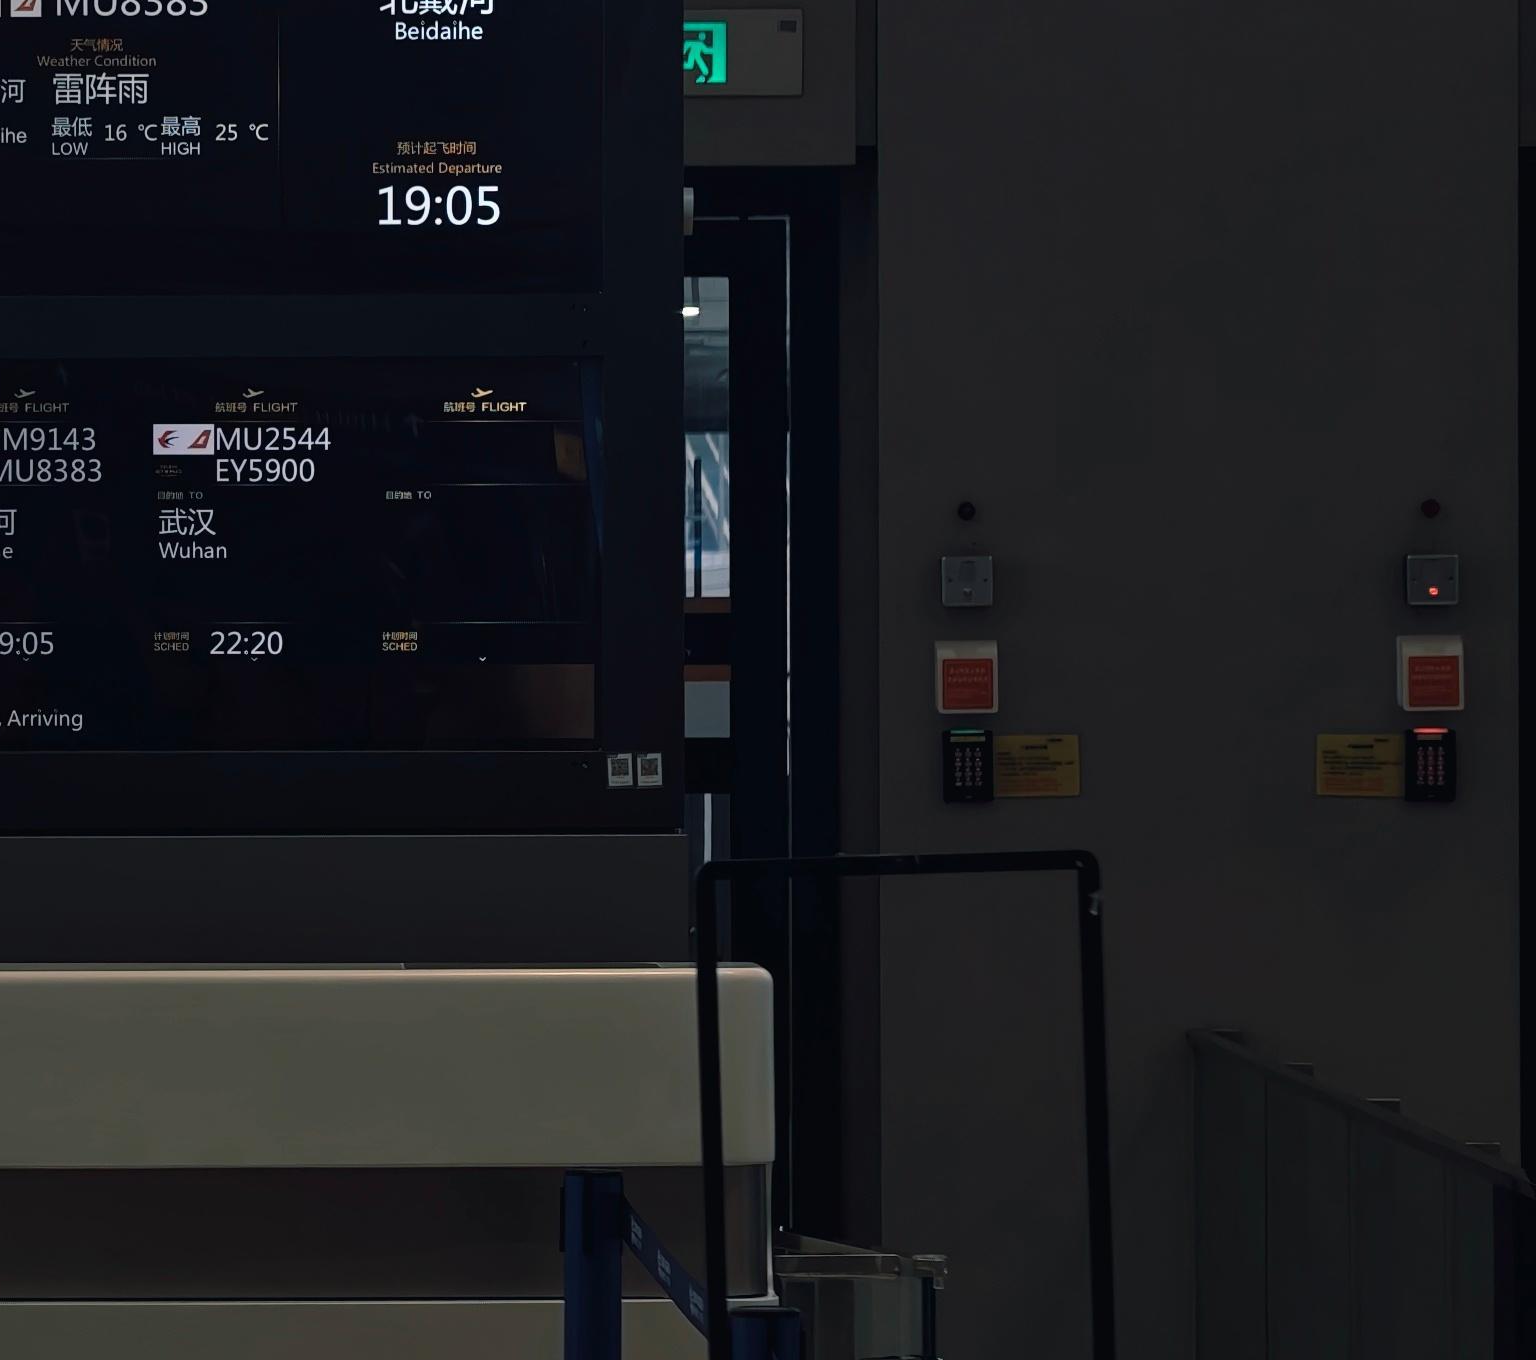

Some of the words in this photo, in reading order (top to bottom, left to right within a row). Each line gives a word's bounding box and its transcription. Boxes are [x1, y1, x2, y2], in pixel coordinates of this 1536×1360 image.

[396, 20, 483, 40] Beidaihe
[37, 55, 91, 66] Weather
[95, 55, 156, 66] Condition
[53, 72, 149, 104] 雷阵雨
[52, 117, 92, 137] 最低
[161, 116, 201, 136] 最高
[52, 142, 88, 155] LOW
[162, 142, 200, 155] HIGH
[397, 141, 476, 155] 预计起飞时间
[373, 162, 433, 173] Estimated
[439, 162, 502, 176] Departure
[379, 186, 500, 225] 19:05
[25, 403, 69, 412] FLIGHT
[254, 402, 298, 412] FLIGHT
[482, 402, 527, 411] FLIGHT
[217, 427, 331, 450] MU2544
[217, 459, 314, 482] EY5900
[417, 491, 431, 499] TO
[159, 508, 216, 535] 武汉
[159, 541, 226, 558] Wuhan
[154, 642, 189, 651] SCHED
[210, 631, 282, 655] 22:20
[383, 642, 417, 651] SCHED
[7, 709, 82, 731] Arriving
